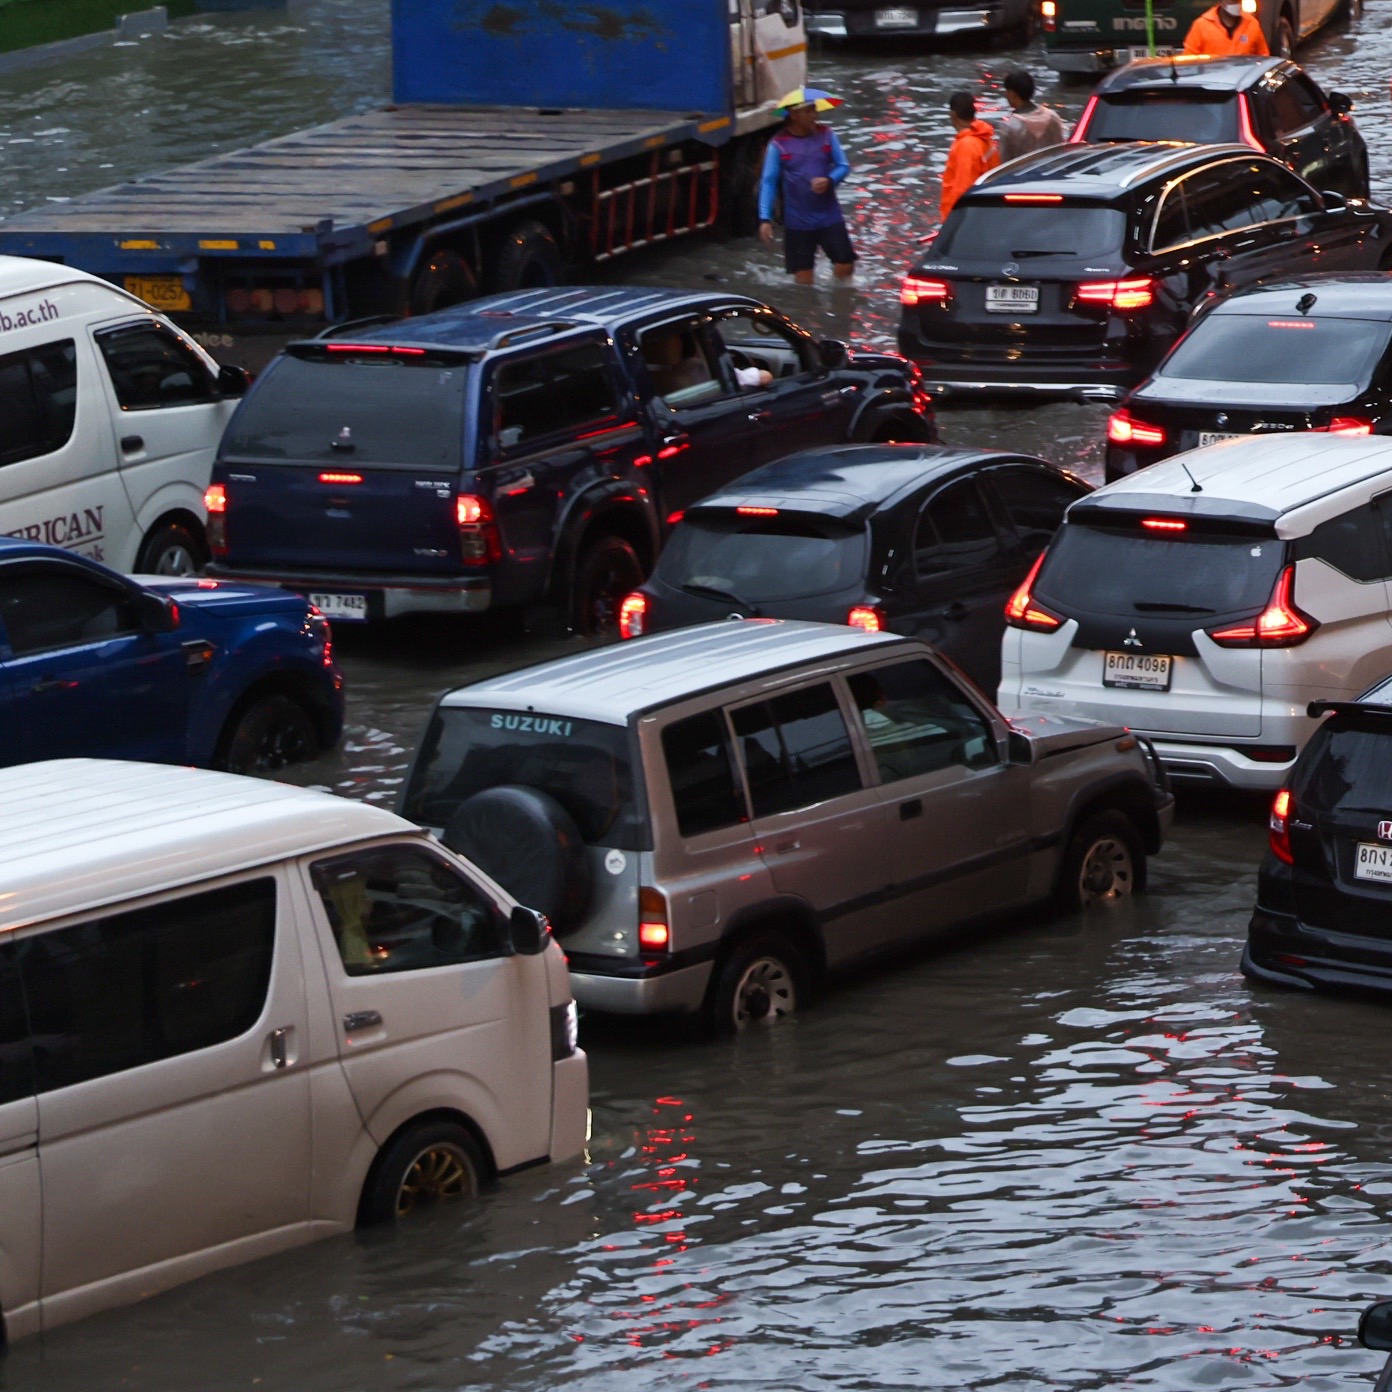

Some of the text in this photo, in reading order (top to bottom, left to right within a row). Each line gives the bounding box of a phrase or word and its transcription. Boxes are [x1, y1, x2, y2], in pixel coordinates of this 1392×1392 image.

[0, 299, 59, 331] b.ac.th
[1137, 655, 1167, 672] 4098
[491, 714, 573, 736] SUZUKI
[1360, 848, 1386, 866] 8กง
